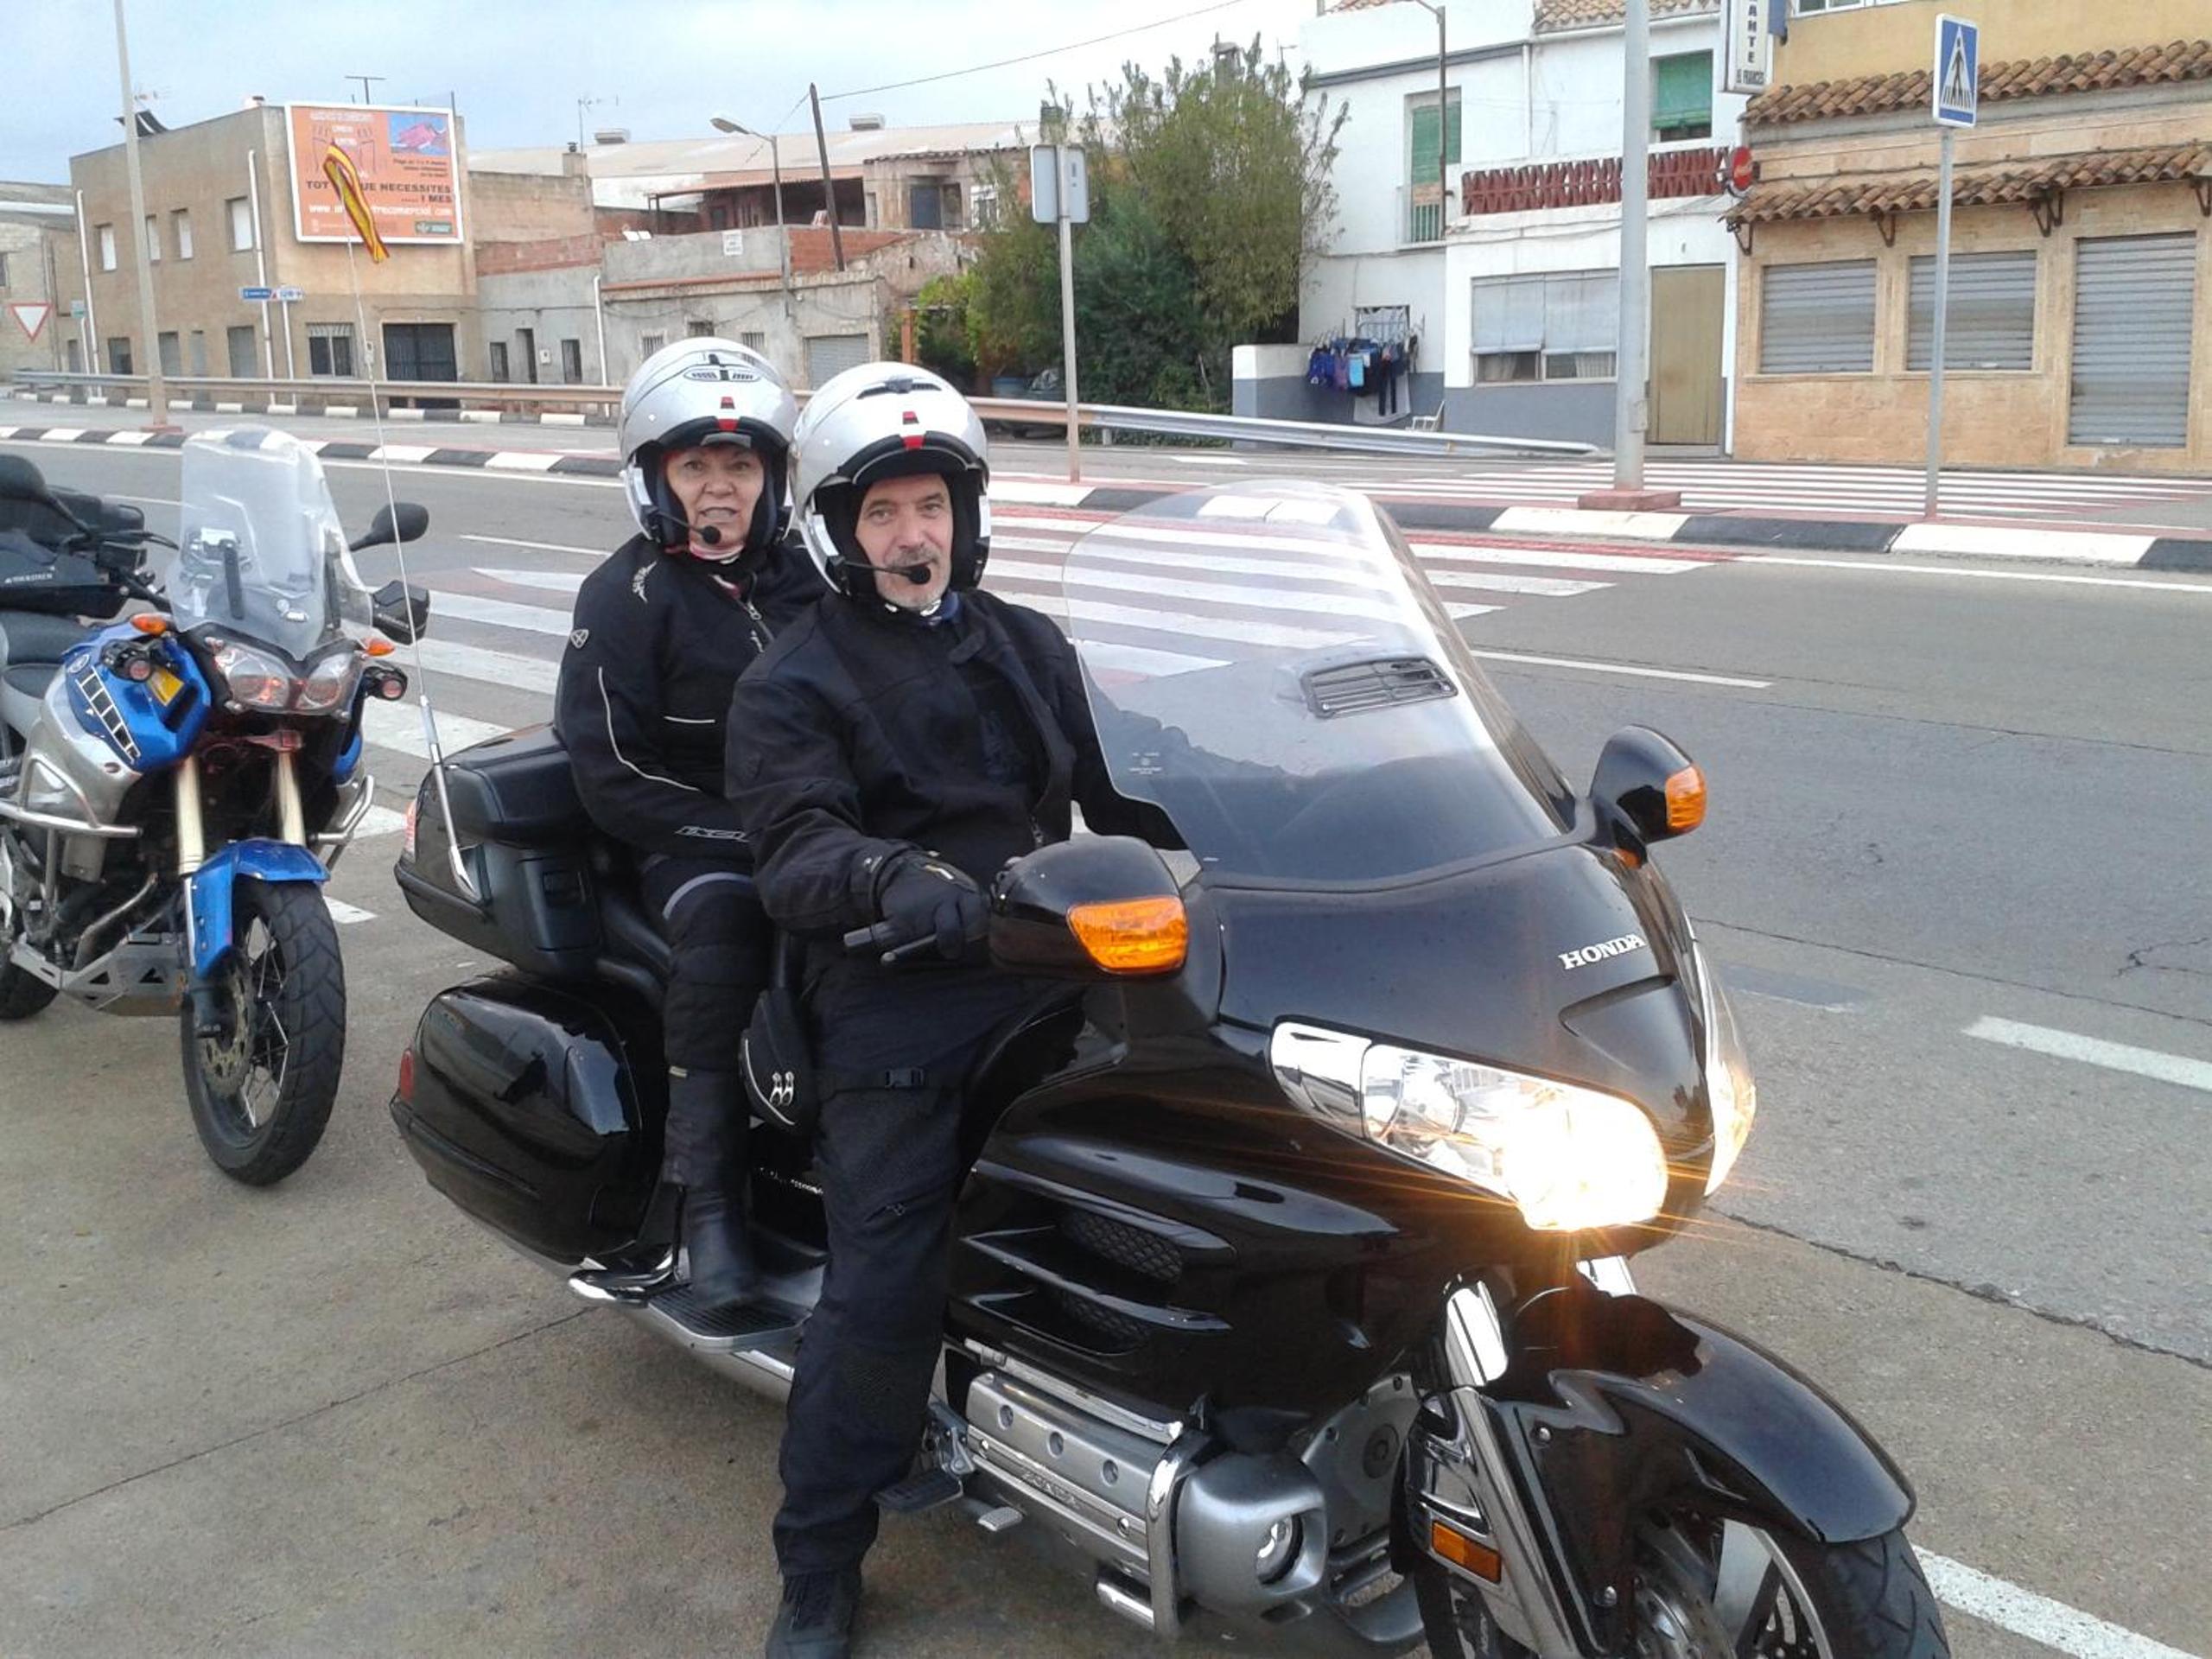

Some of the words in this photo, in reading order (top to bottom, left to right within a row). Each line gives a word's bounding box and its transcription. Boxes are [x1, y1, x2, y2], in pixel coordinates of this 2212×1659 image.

[1748, 0, 1758, 63] ANTE
[307, 181, 329, 189] TOT
[380, 182, 451, 194] NECESSITES
[1558, 933, 1646, 969] HONDA
